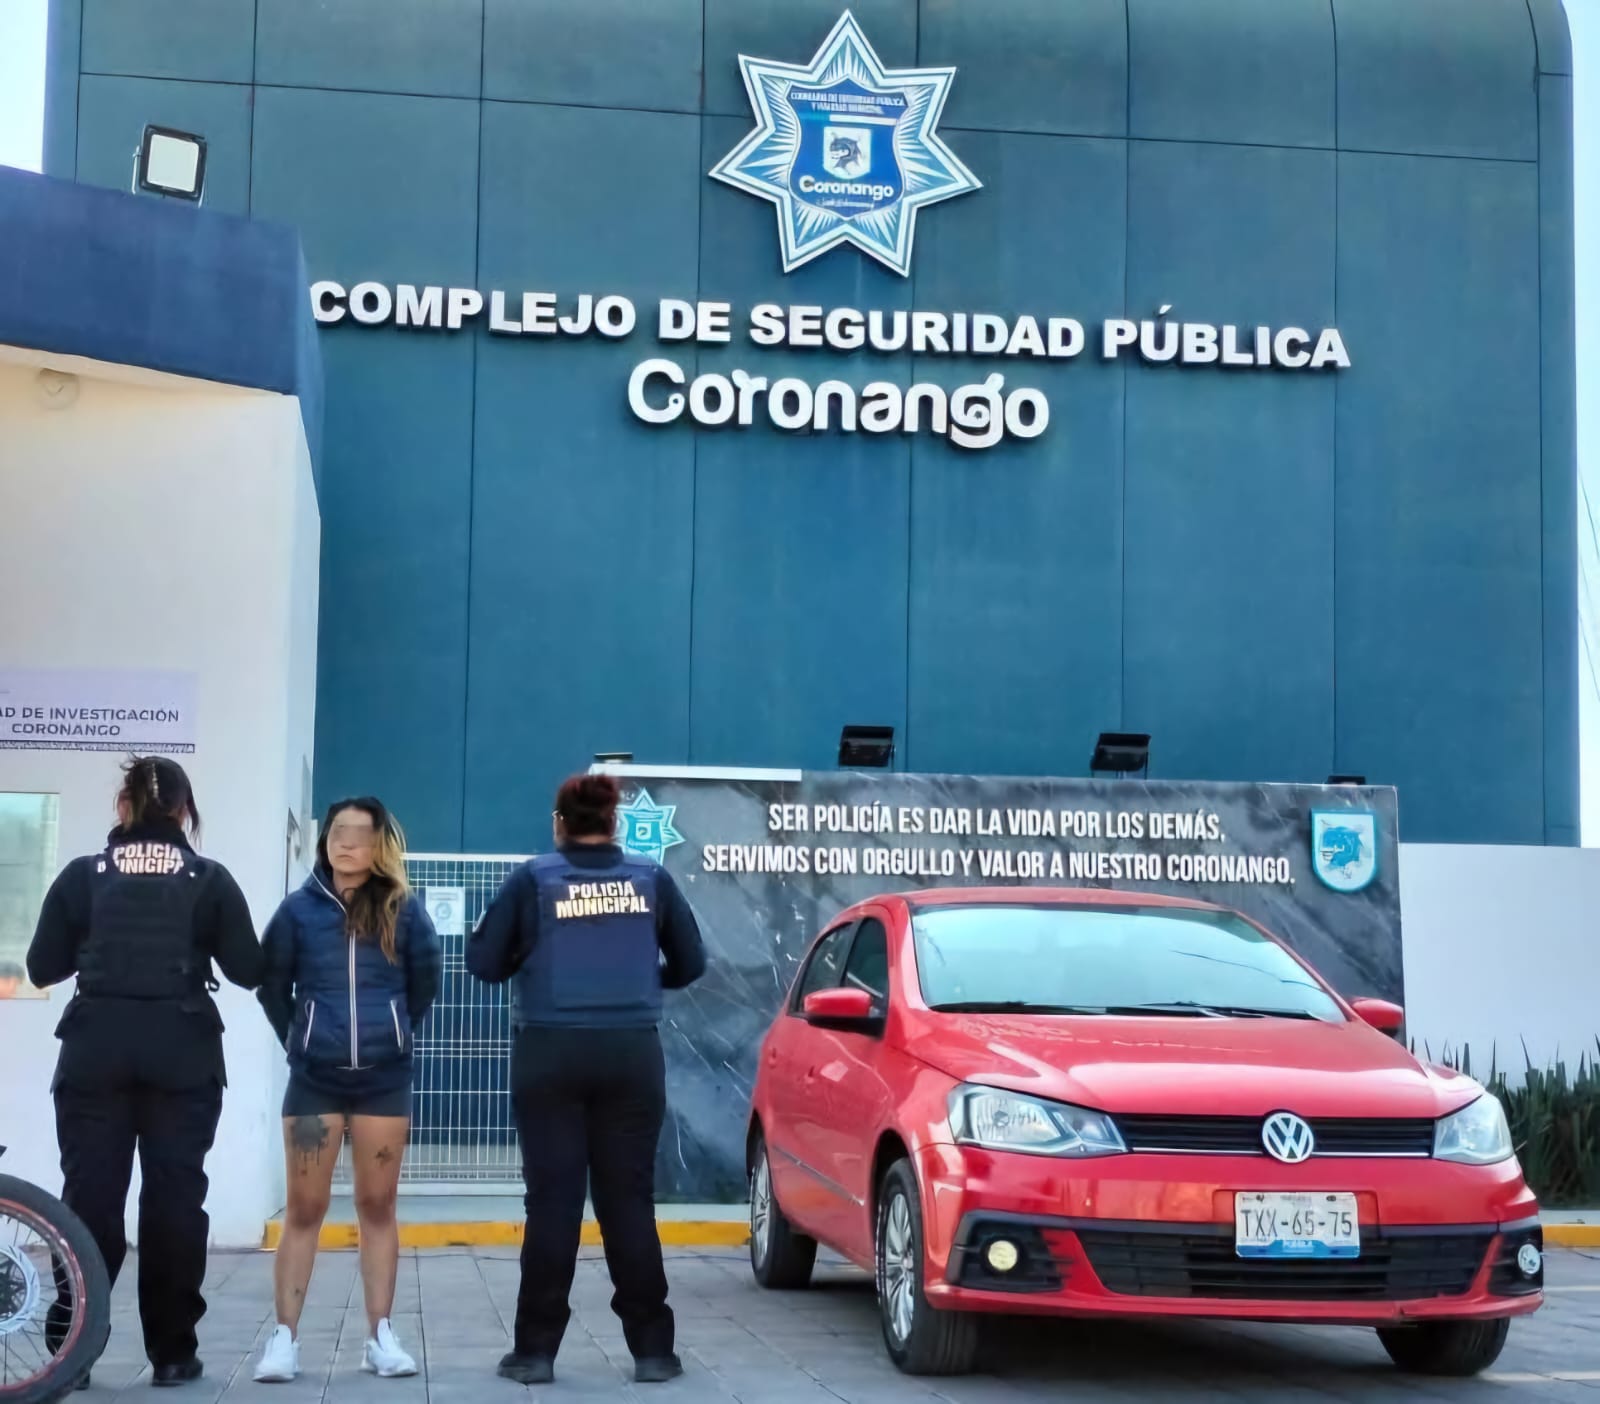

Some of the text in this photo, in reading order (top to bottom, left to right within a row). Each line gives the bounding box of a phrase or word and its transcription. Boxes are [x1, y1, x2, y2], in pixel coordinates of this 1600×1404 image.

[799, 175, 894, 200] Coronango
[310, 280, 1351, 368] COMPLEJO DE SEGURIDAD PÚBLICA
[628, 358, 1050, 449] Coronango
[22, 707, 44, 719] DE
[50, 707, 179, 722] INVESTIGACIÓN
[12, 723, 120, 736] CORONANGO
[768, 801, 1226, 843] SER POLICÍA ES DAR LA VIDA POR LOS DEMÁS,
[703, 844, 1296, 885] SERVIMOS CON ORGULLO Y VALOR A NUESTRO CORONANGO.
[568, 880, 635, 900] POLICIA
[556, 896, 650, 919] MUNICIPAL
[1240, 1208, 1352, 1238] TXX-65-75
